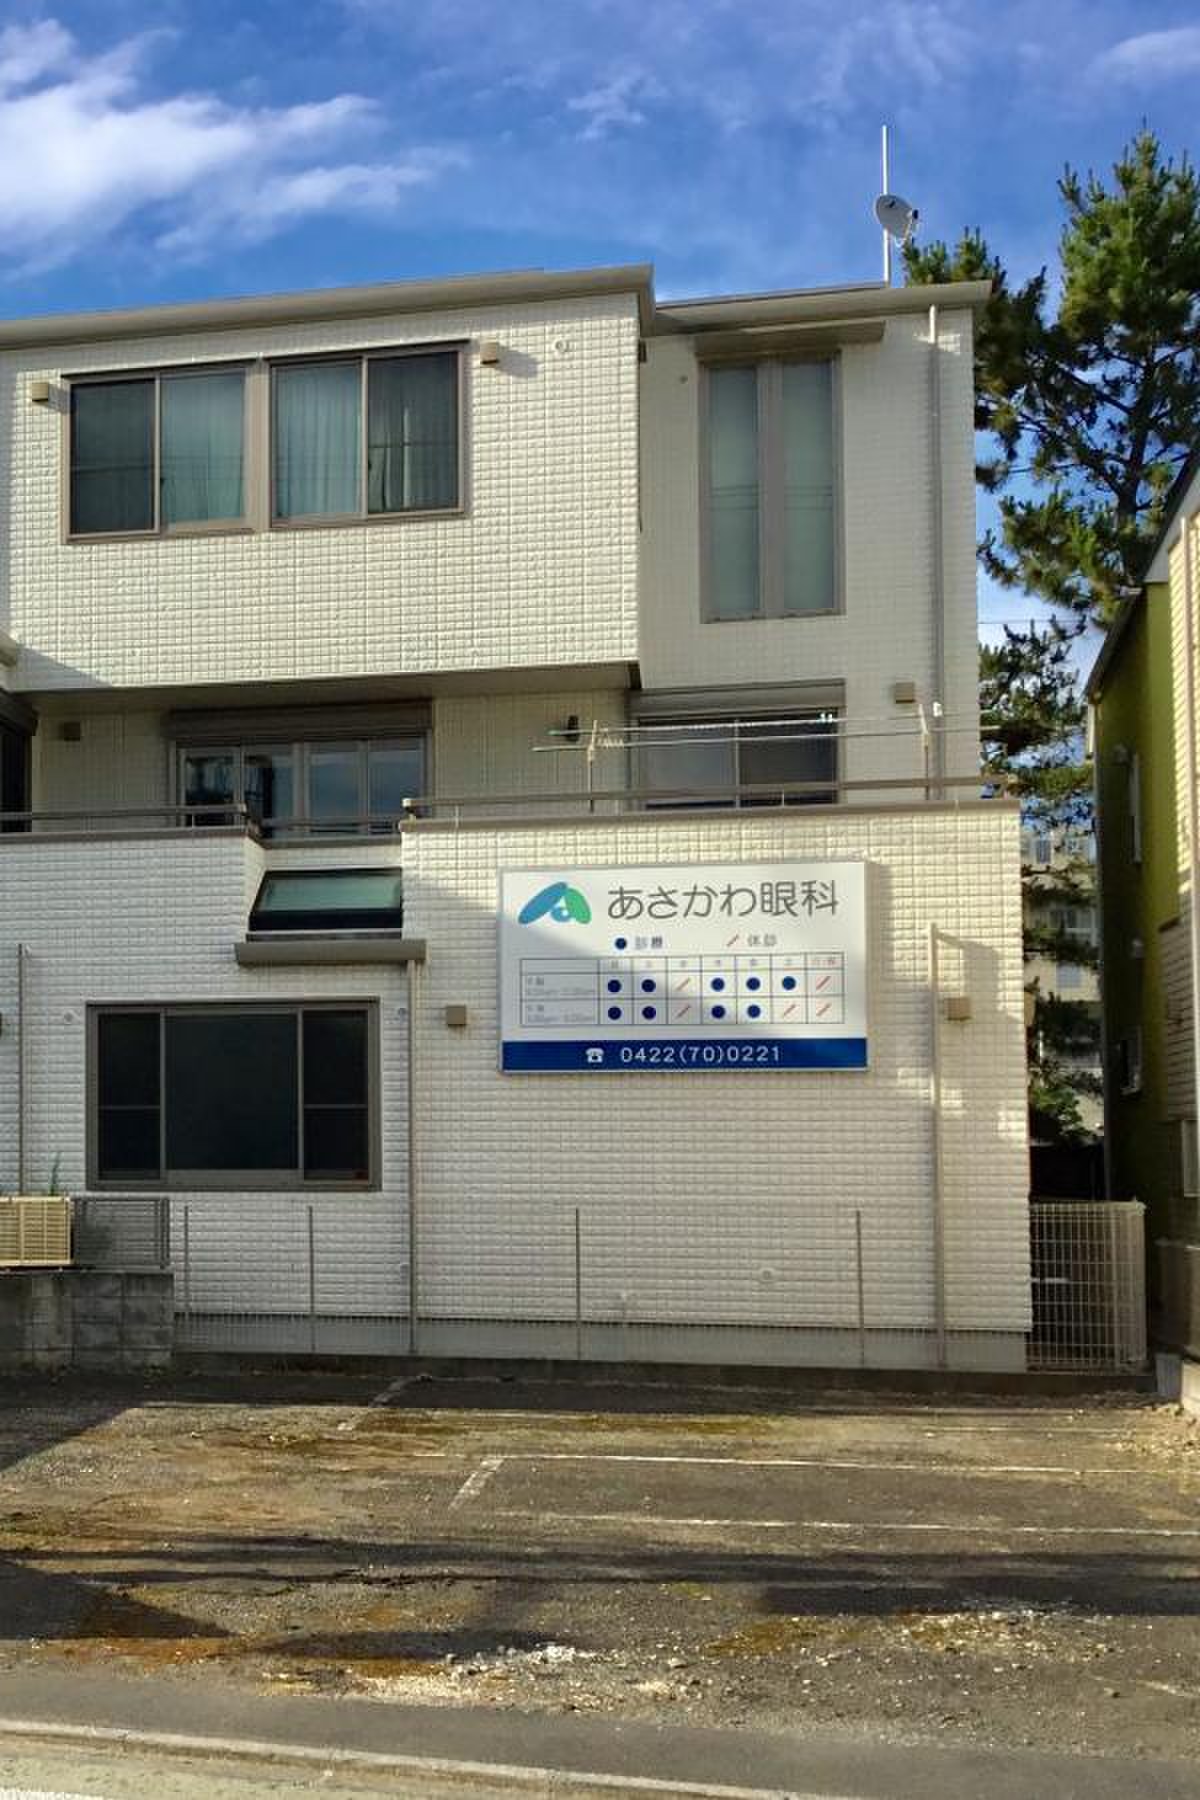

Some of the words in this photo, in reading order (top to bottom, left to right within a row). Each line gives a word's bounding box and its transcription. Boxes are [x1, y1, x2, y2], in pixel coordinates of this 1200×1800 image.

[607, 879, 839, 920] あさかわ眼科
[620, 1045, 781, 1064] 0422(70)0221
